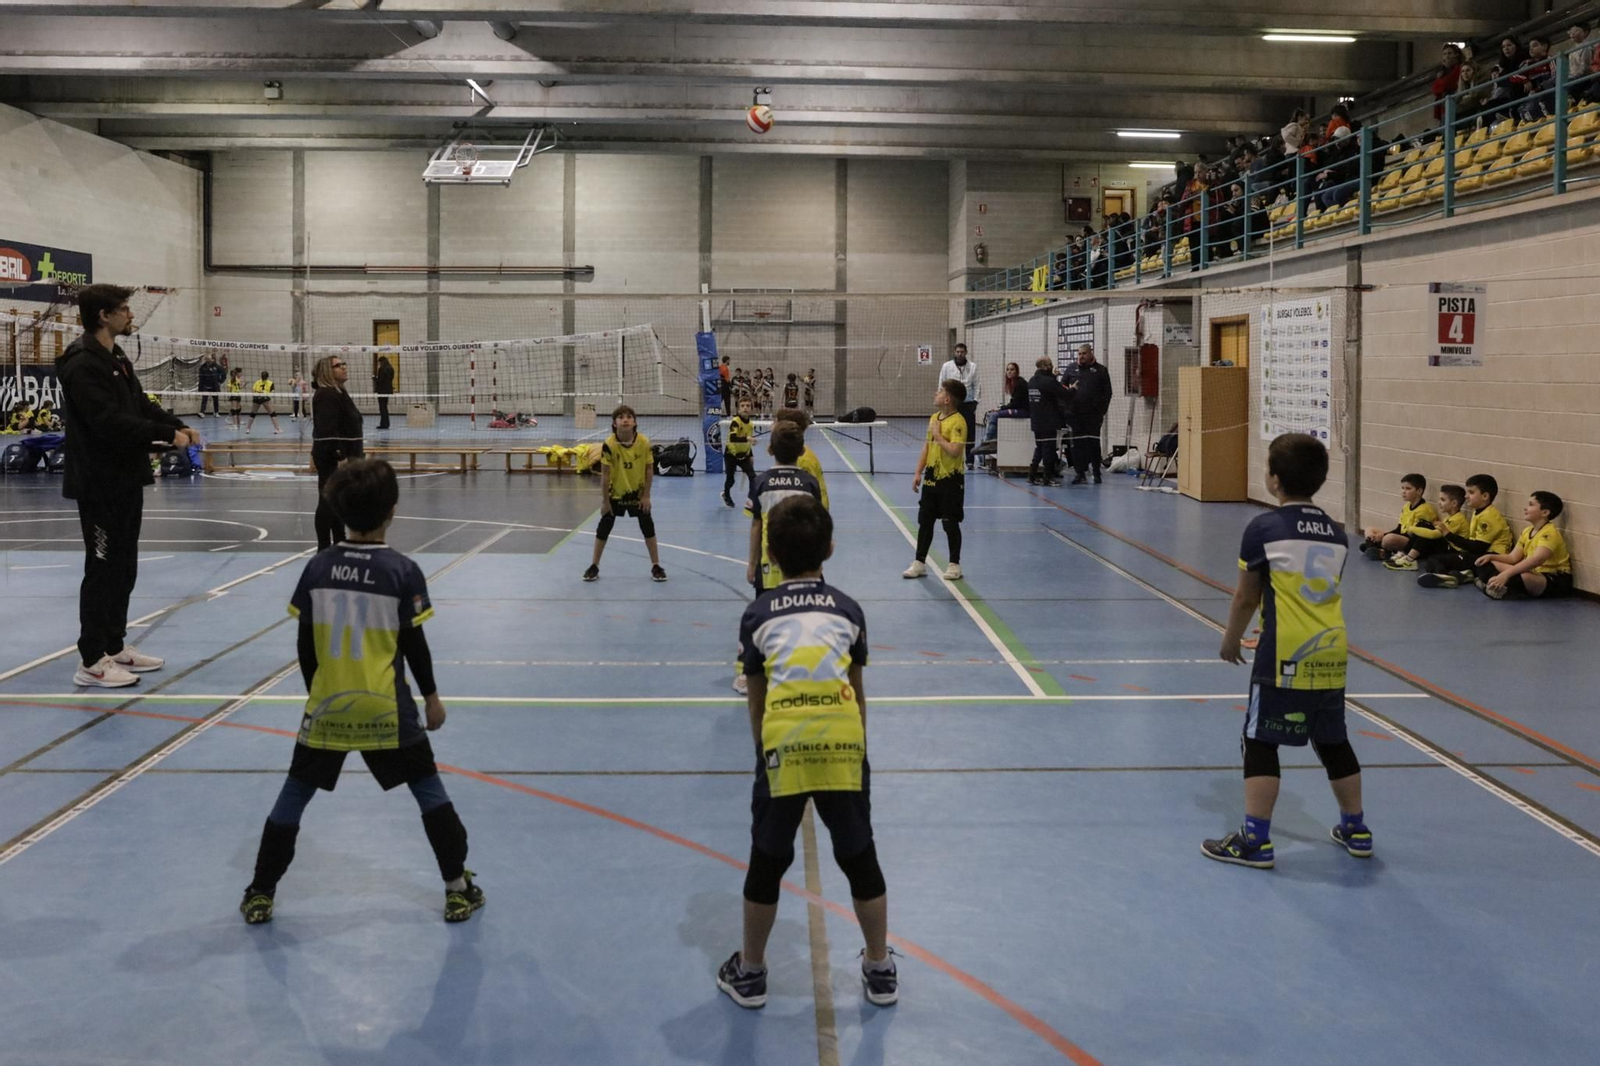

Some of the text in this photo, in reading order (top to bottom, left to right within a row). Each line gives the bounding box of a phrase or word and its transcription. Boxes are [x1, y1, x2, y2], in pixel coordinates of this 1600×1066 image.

[1438, 297, 1476, 313] PISTA
[1448, 314, 1464, 343] 4
[189, 339, 207, 347] CLUB
[239, 343, 270, 351] OURENSE
[1440, 346, 1472, 355] MINIVOLEI
[623, 462, 633, 470] 23
[768, 477, 804, 487] SARA D.
[1297, 520, 1334, 537] CARLA
[331, 565, 375, 585] NOA L.
[1300, 545, 1336, 603] 5
[770, 593, 836, 613] ILDUARA
[330, 592, 370, 662] 11
[771, 692, 843, 711] codisoil
[784, 741, 830, 754] CLÍNICA
